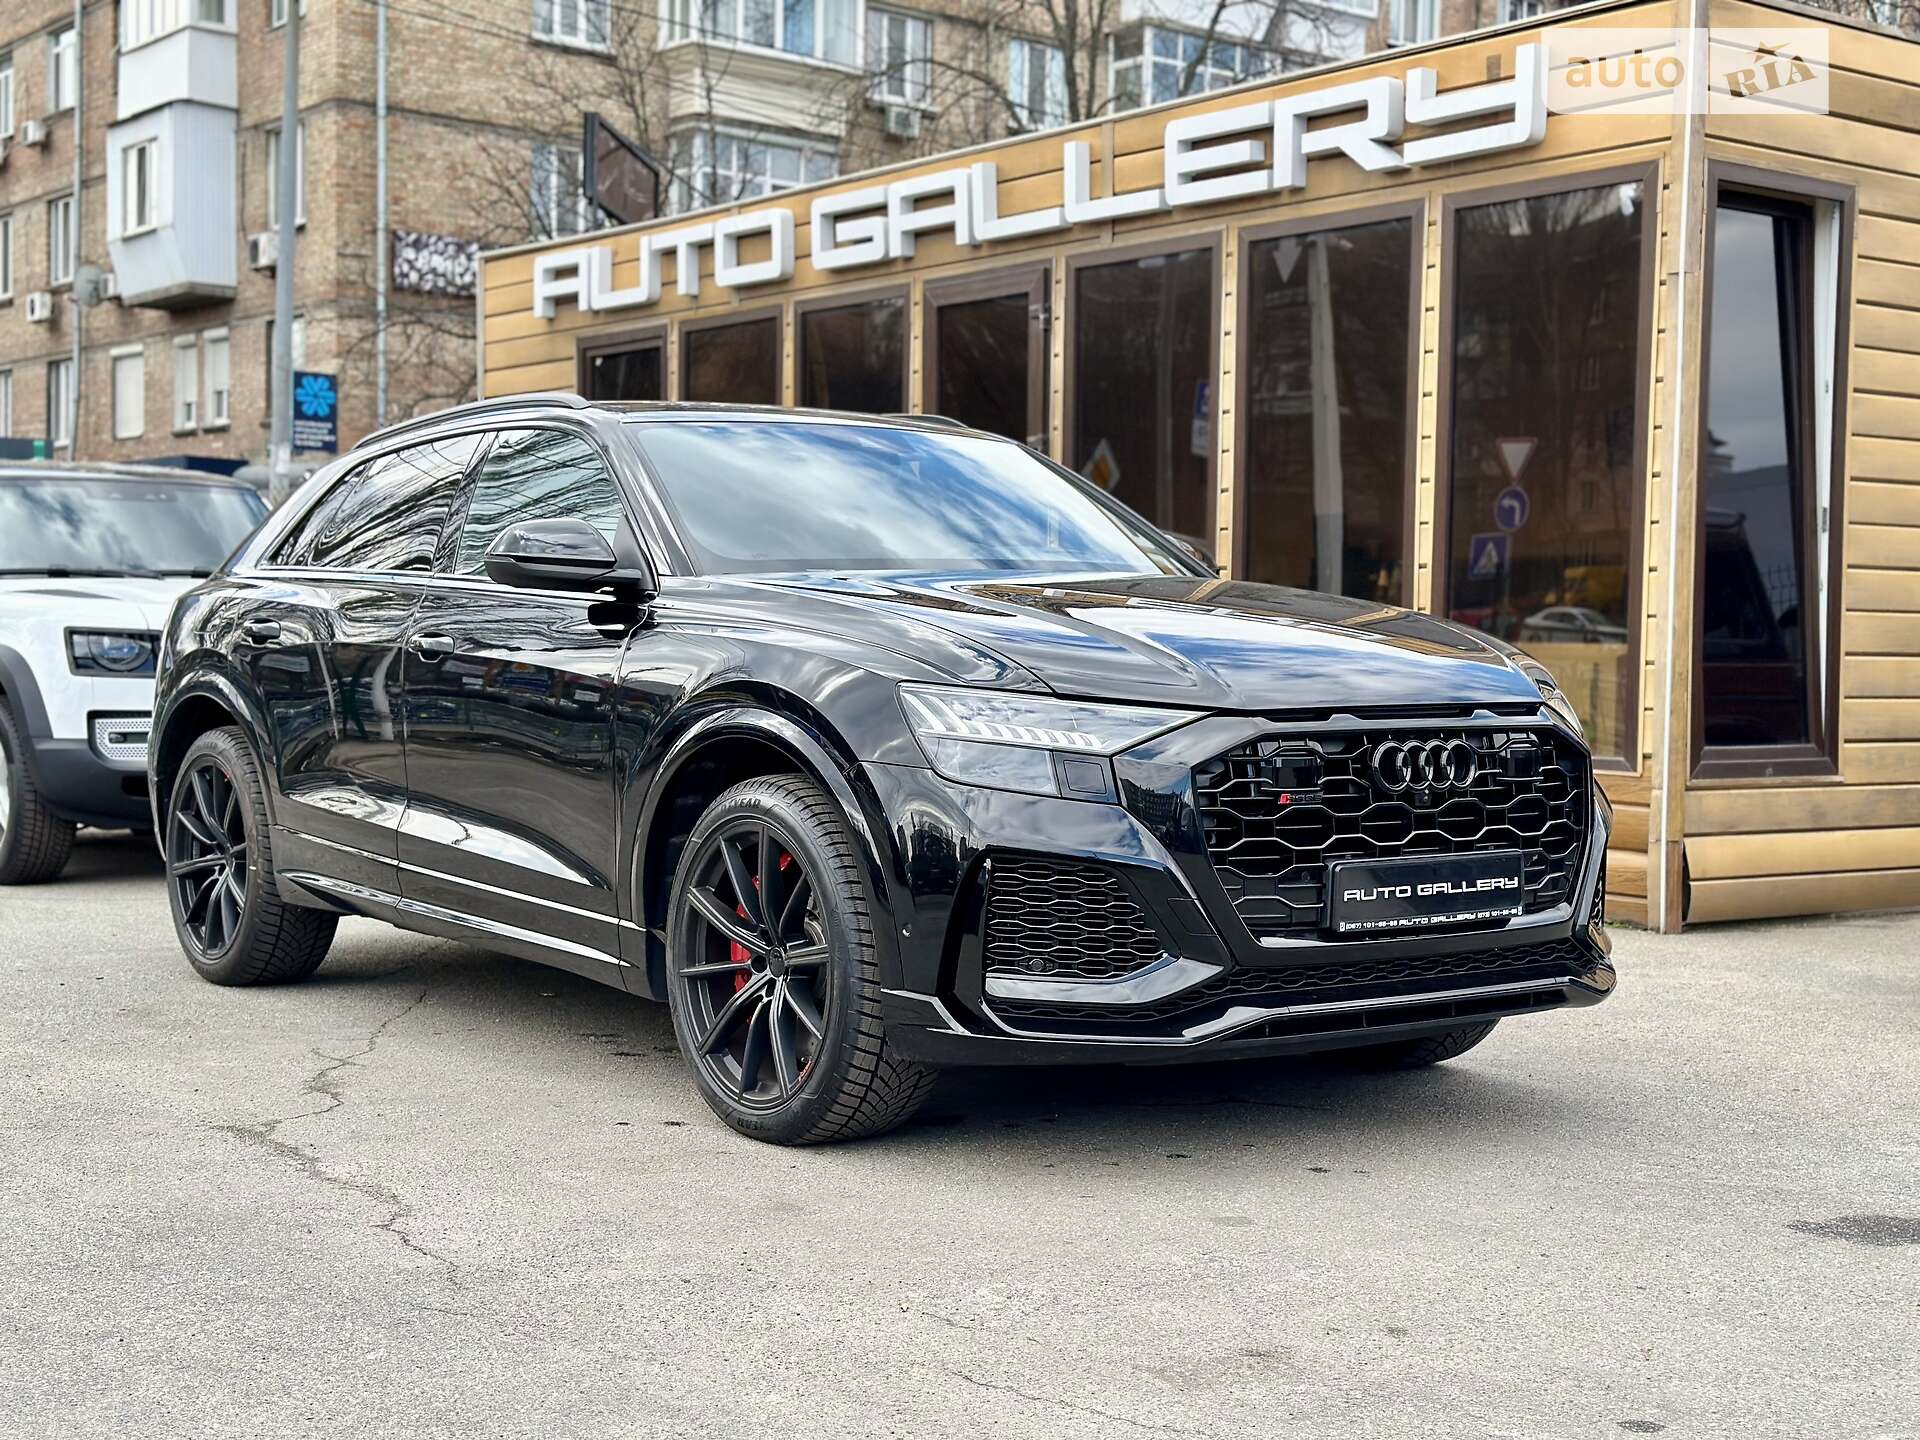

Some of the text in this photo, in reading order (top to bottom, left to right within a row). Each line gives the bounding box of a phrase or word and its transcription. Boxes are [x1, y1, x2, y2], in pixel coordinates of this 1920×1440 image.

[533, 43, 1548, 319] AUTO GALLERY
[1343, 876, 1519, 902] AUTO GALLERY
[1399, 917, 1428, 926] AUTO
[1431, 913, 1476, 924] GALLERY
